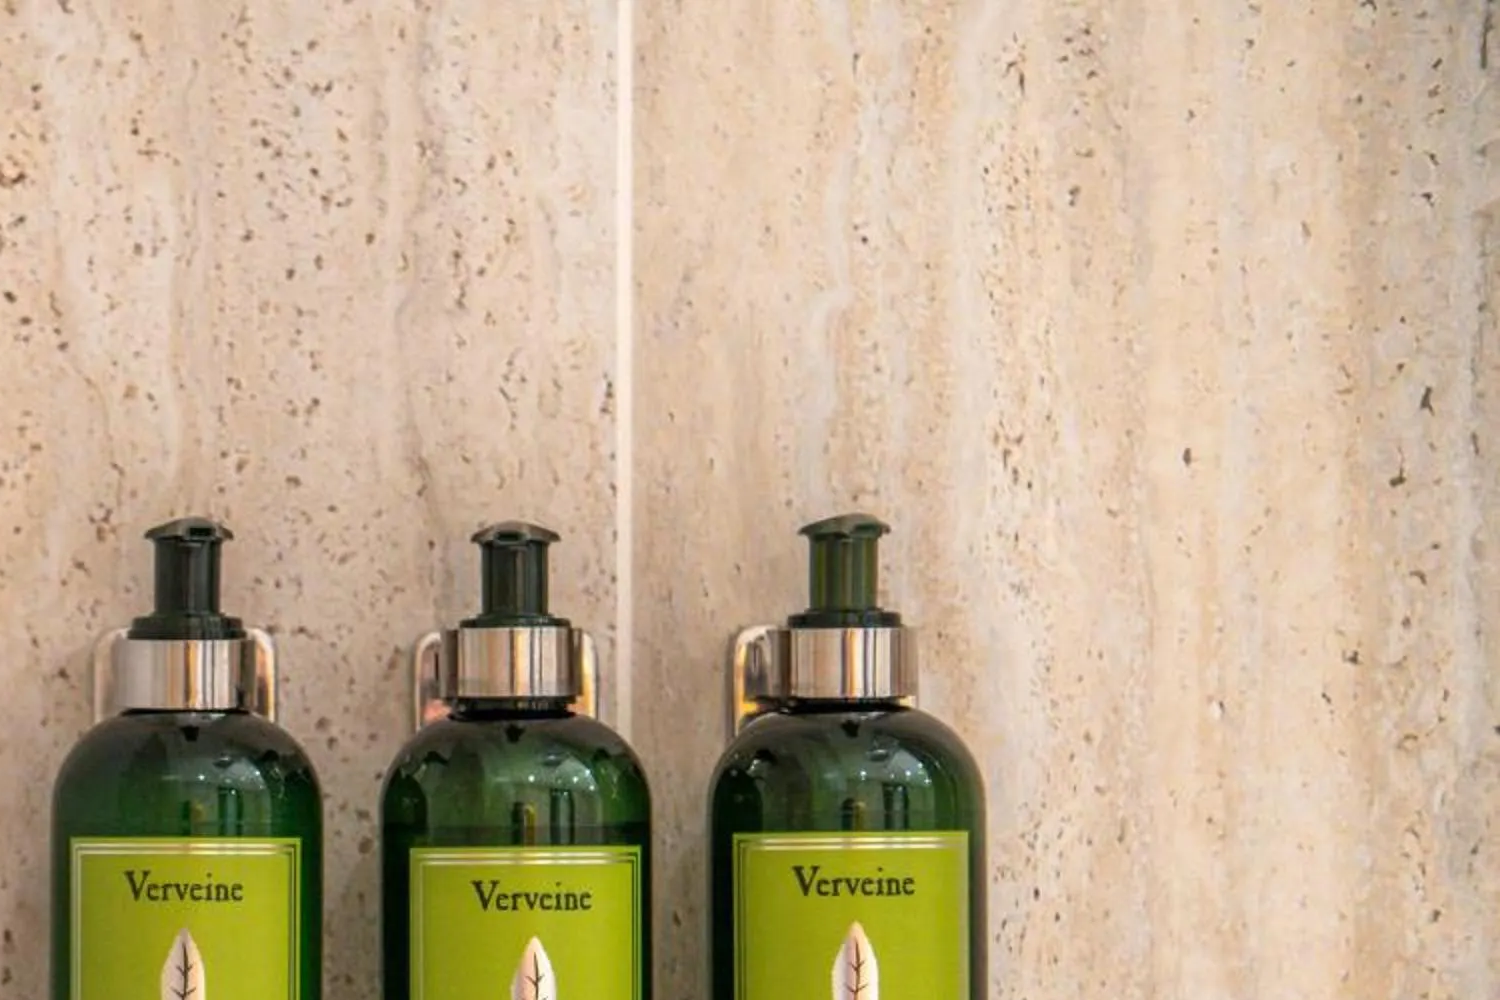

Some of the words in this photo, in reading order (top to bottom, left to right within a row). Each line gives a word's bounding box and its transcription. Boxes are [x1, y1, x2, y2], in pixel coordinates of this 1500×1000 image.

[125, 869, 244, 902] Verveine
[471, 879, 592, 912] Verveine
[792, 865, 916, 897] Verveine
